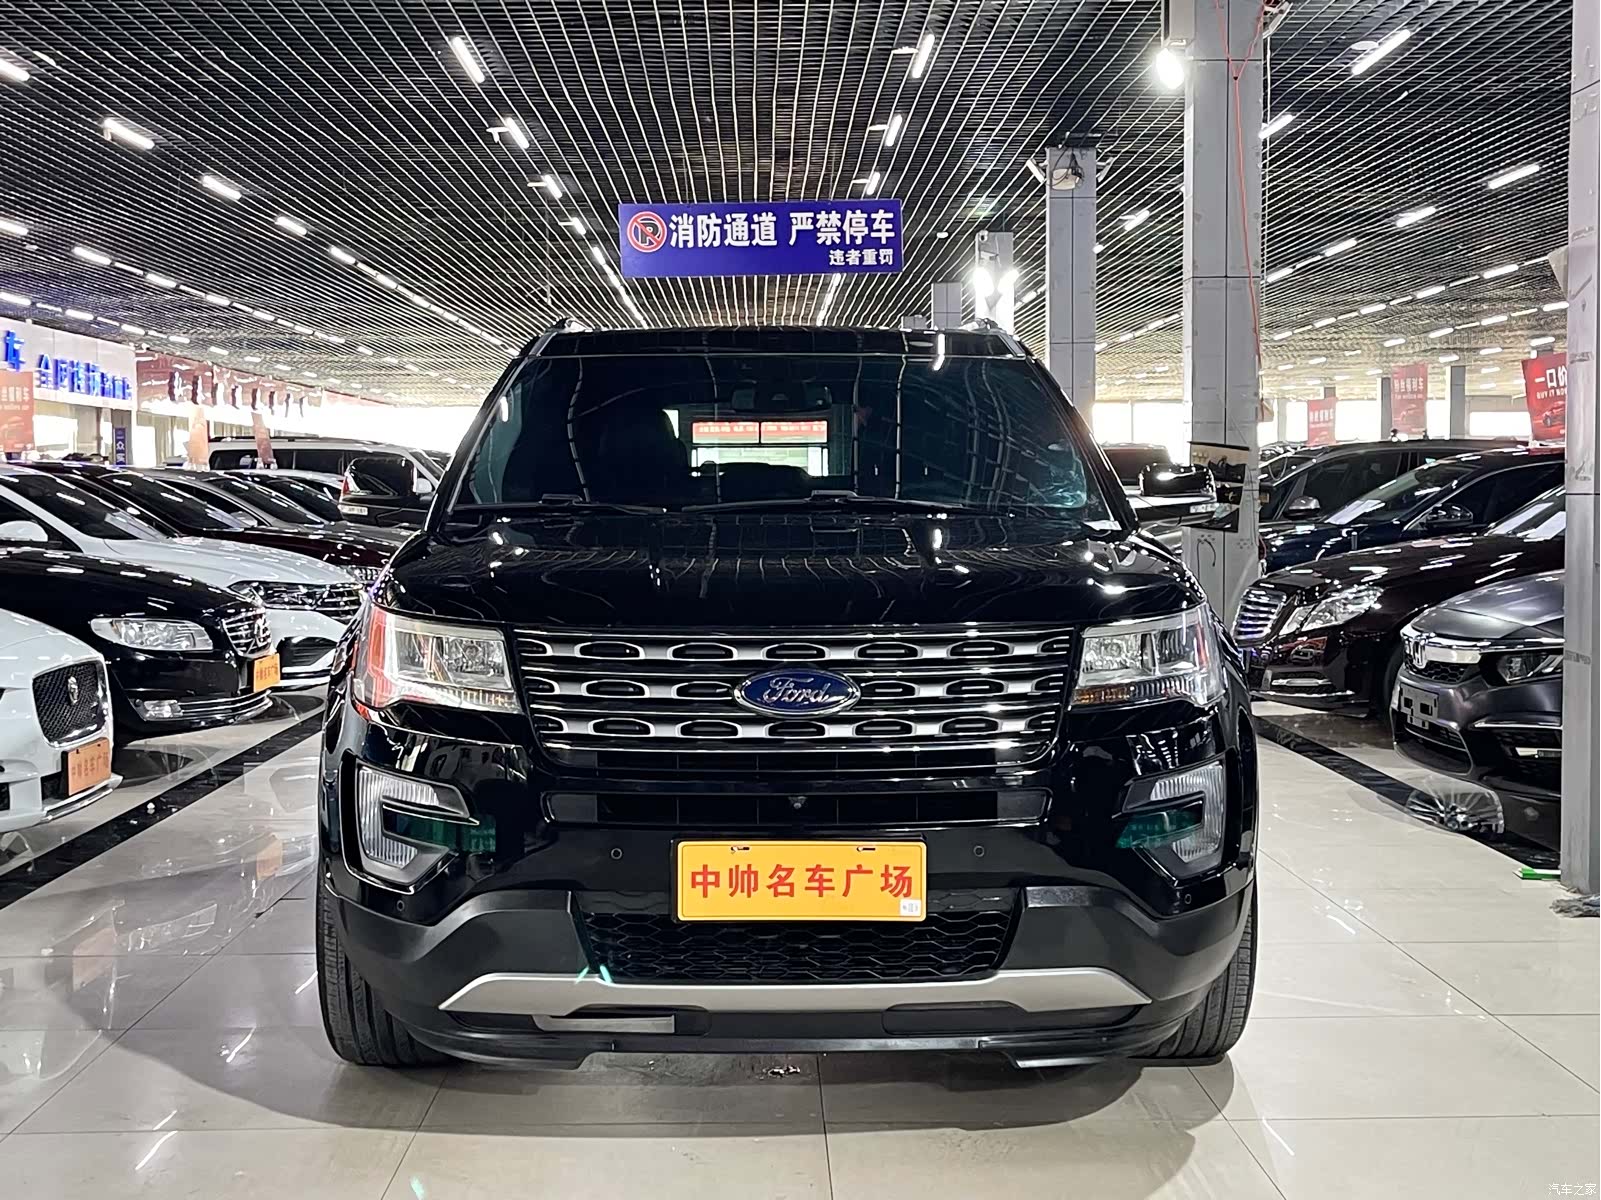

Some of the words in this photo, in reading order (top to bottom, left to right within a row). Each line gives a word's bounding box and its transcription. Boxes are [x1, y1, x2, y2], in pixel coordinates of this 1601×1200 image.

[668, 211, 777, 248] 消防通道
[788, 209, 895, 246] 严禁停车
[828, 248, 894, 266] 违者重罚
[762, 677, 832, 703] Ford
[690, 863, 913, 899] 中帅名车广场
